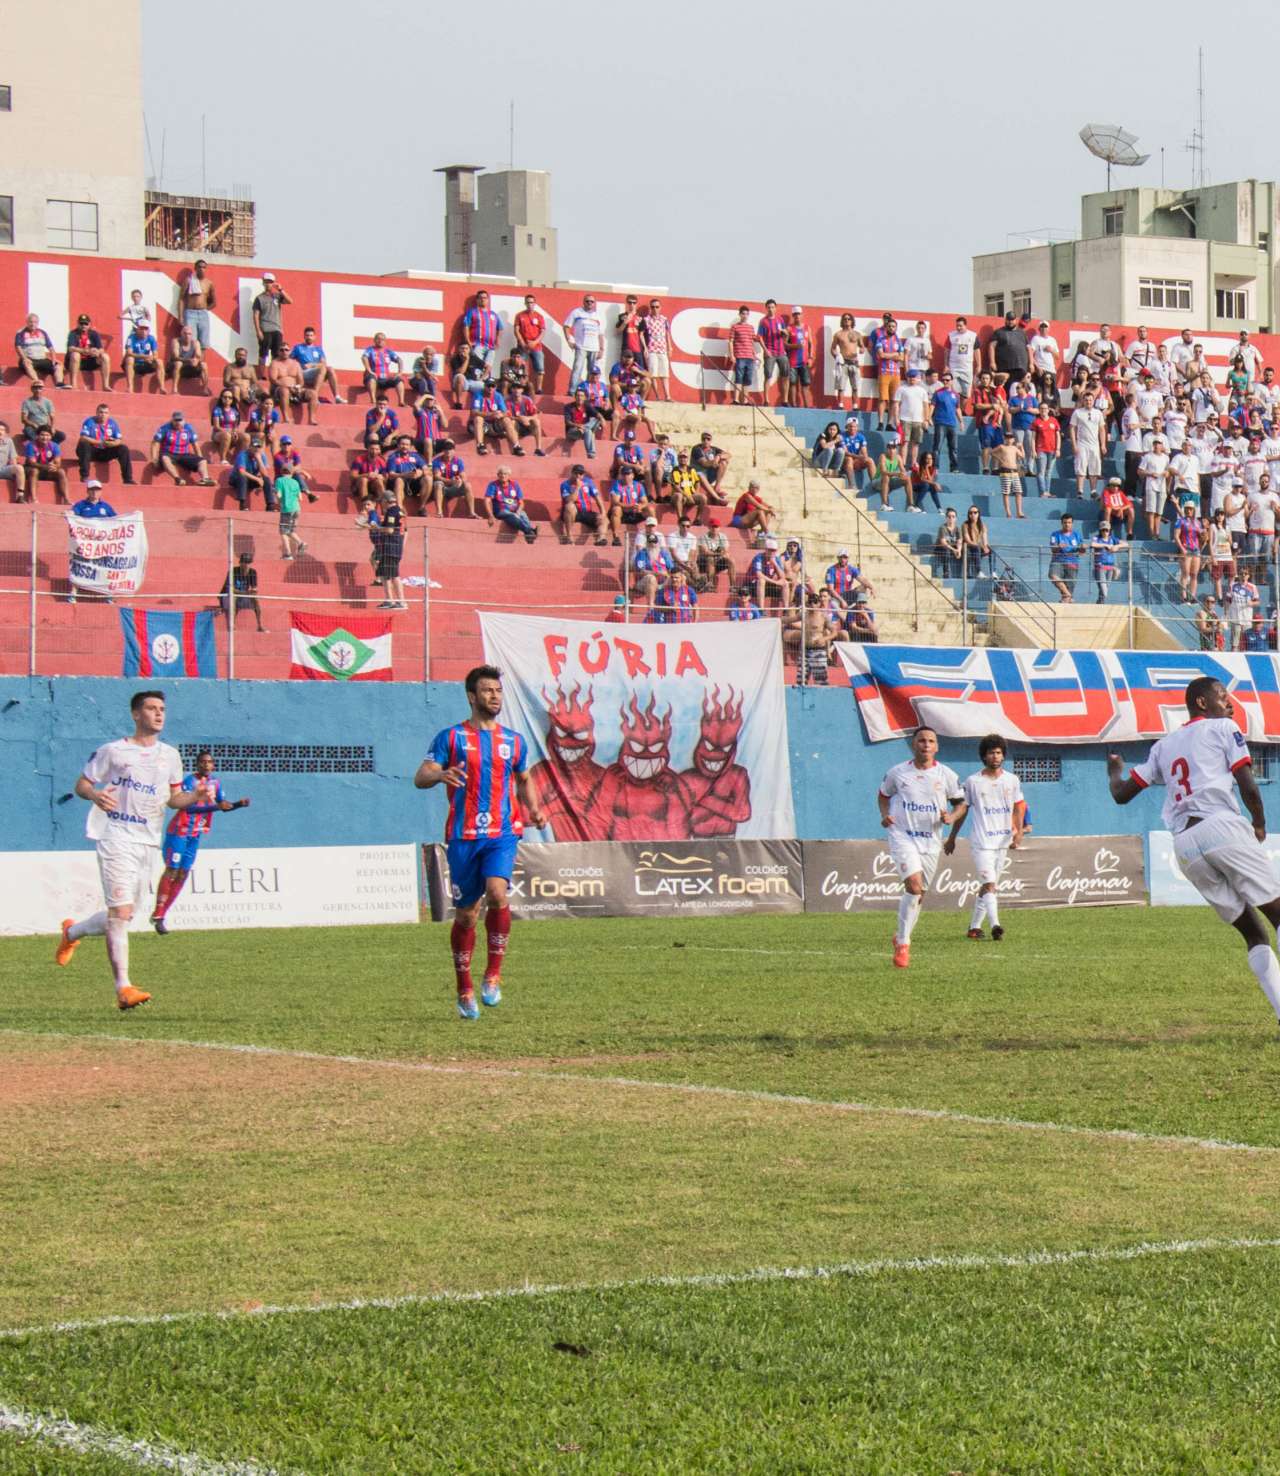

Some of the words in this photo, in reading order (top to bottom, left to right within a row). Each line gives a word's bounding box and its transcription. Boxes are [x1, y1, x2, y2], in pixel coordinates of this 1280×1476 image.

[94, 543, 126, 556] ANOS
[543, 630, 708, 680] FÚRIA
[1171, 757, 1193, 802] 3
[359, 850, 411, 861] PROJETOS
[355, 867, 411, 878] REFORMAS
[558, 866, 604, 878] COLCHÕES
[744, 864, 789, 875] COLCHÕES
[530, 876, 605, 897] foam
[634, 875, 714, 896] LATEX
[718, 873, 789, 895] foam
[821, 870, 905, 910] Cajoma
[935, 868, 1025, 908] Cajoar
[1046, 866, 1133, 904] Cajomar
[321, 900, 413, 912] GERENCIAMENTO
[519, 902, 568, 912] LONGEVIDADE
